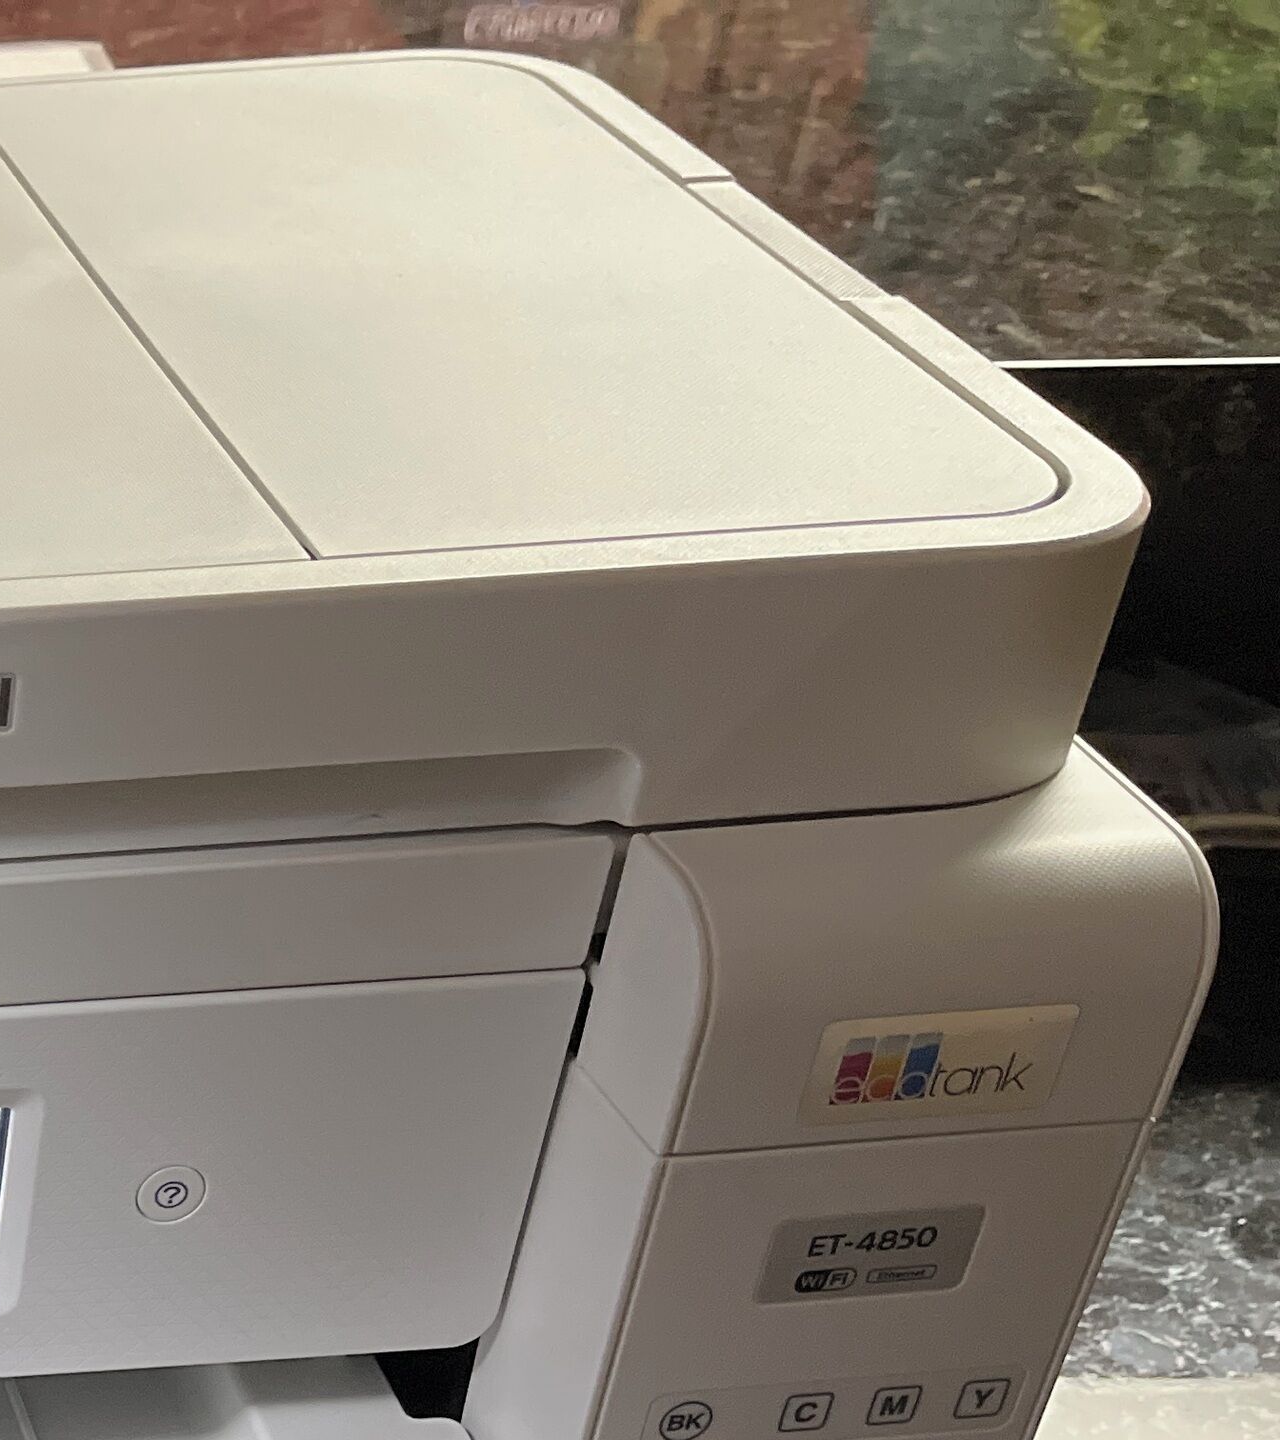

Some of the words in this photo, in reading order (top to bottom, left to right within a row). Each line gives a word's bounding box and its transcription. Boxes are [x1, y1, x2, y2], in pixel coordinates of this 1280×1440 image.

[807, 1226, 938, 1258] ET-4850
[878, 1395, 909, 1417] M
[974, 1388, 995, 1409] Y
[666, 1412, 705, 1432] BK
[794, 1401, 818, 1423] C
